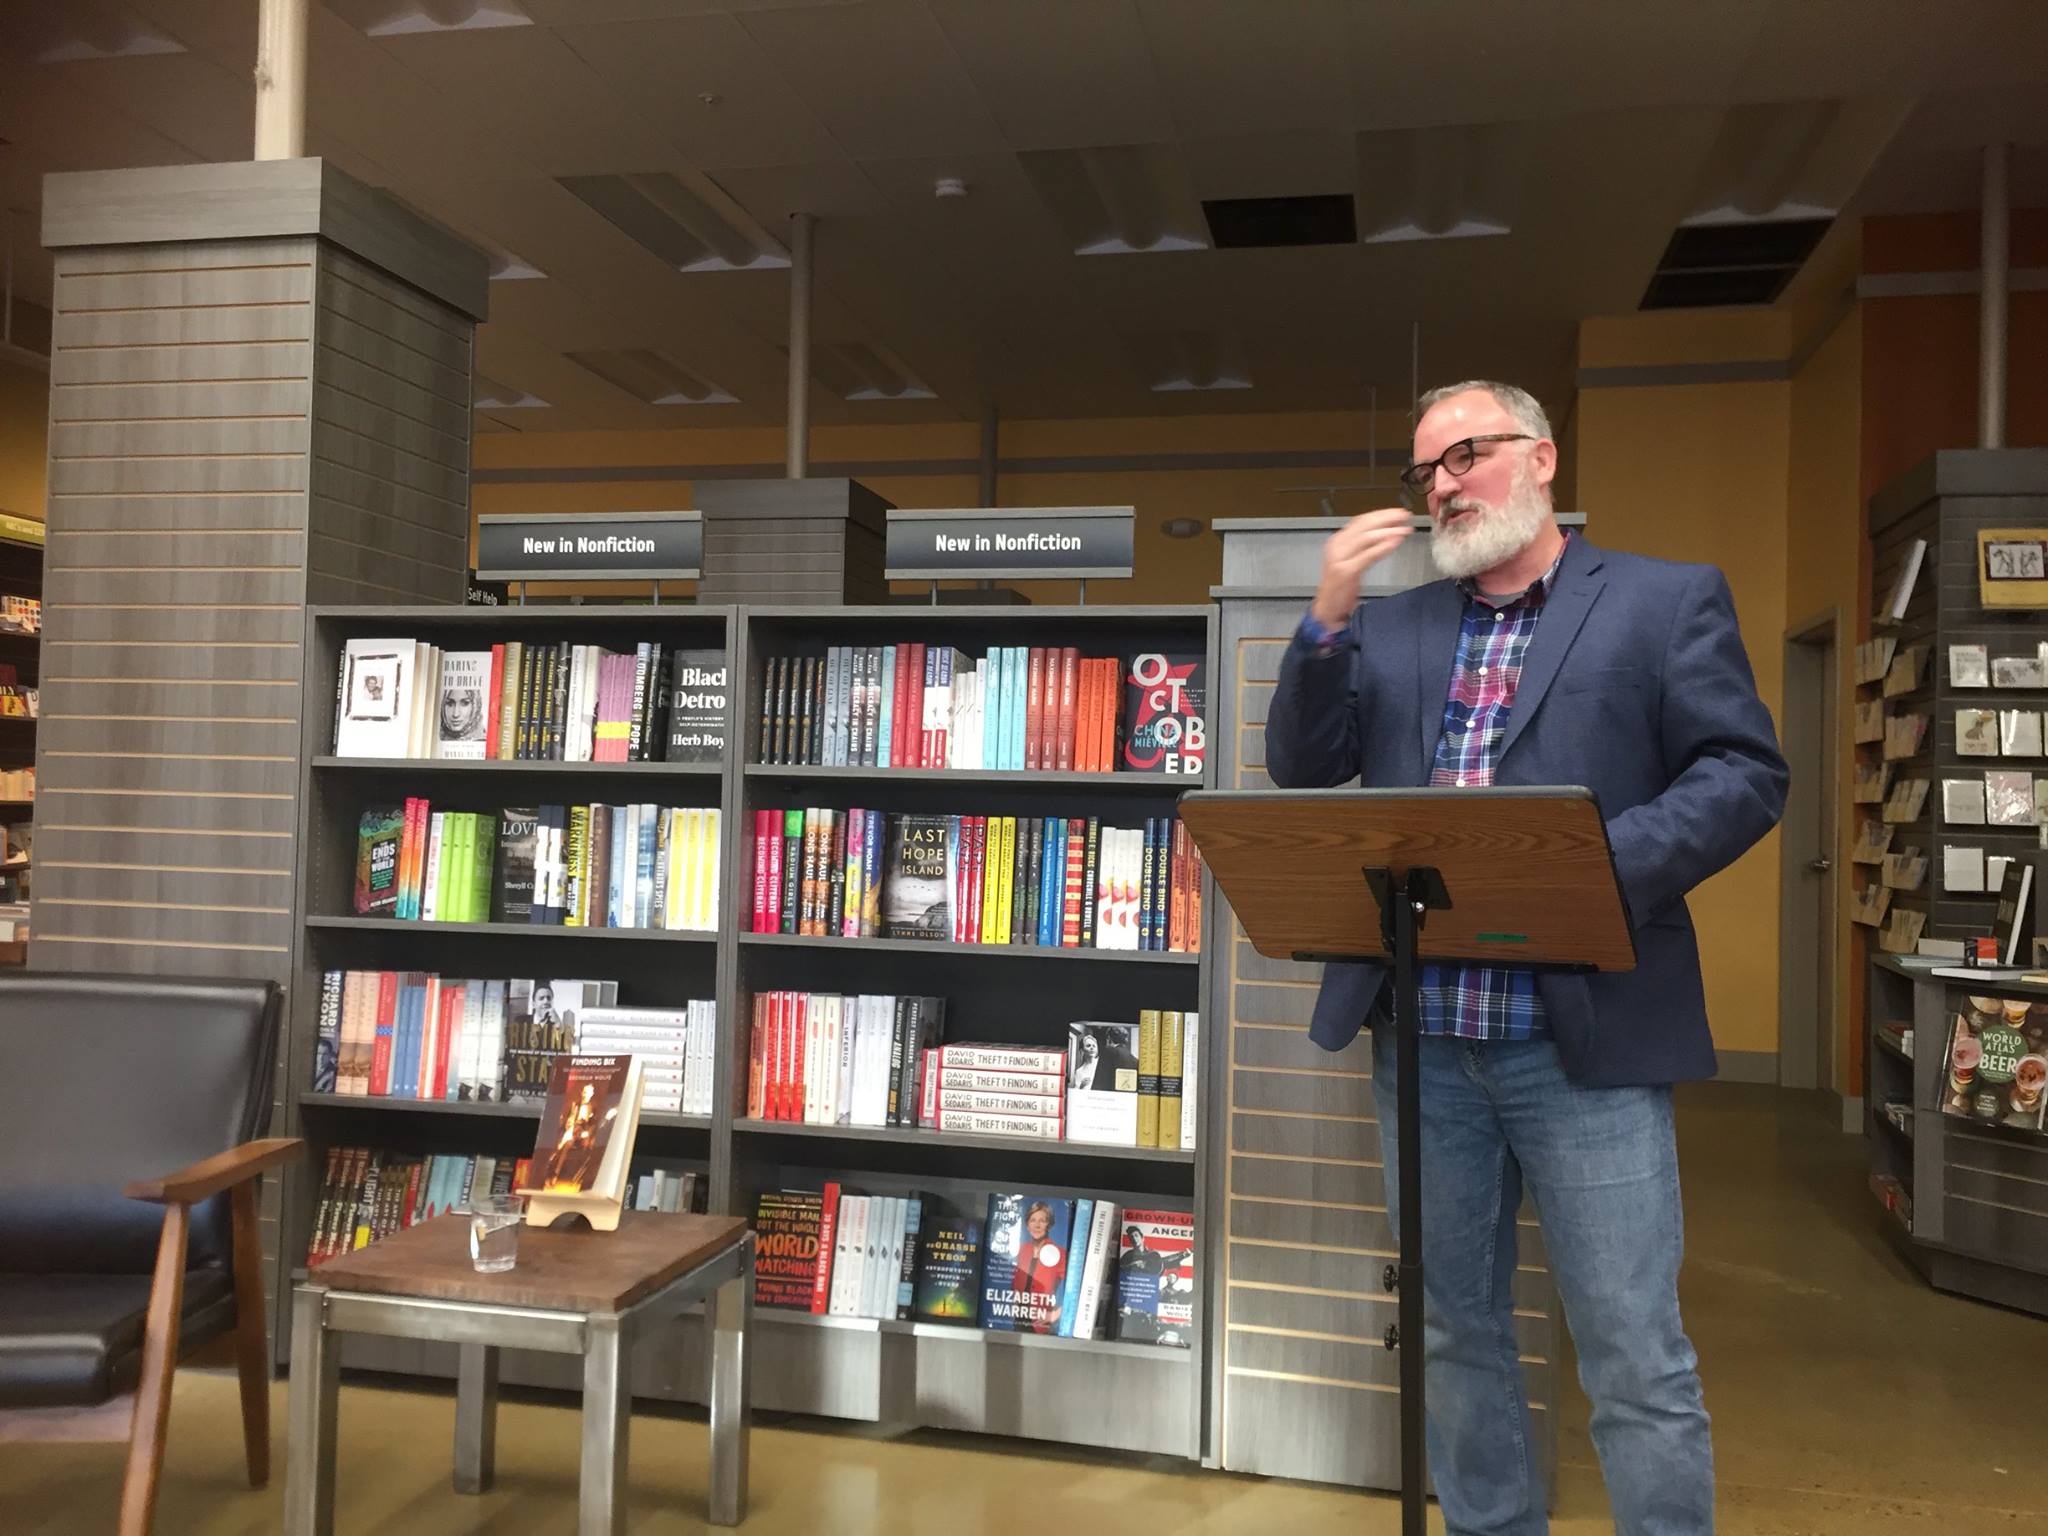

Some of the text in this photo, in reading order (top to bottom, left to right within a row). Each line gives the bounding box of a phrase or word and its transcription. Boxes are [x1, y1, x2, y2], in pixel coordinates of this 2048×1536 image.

[524, 536, 655, 554] New in Nonfiction
[936, 533, 1081, 551] New in Nonfiction
[468, 588, 498, 606] Self Help
[630, 652, 646, 750] BLOOMBERG POPE
[850, 677, 861, 752] DEMOCRACY IN CHAINS
[864, 677, 875, 752] DEMOCRACY IN CHAINS
[672, 734, 700, 746] Herb
[904, 829, 945, 842] LAST
[1089, 820, 1097, 842] THOMAS
[568, 810, 584, 874] WARNINGS
[960, 824, 971, 872] PAPI
[973, 824, 984, 872] PAPI
[372, 843, 395, 860] ENDS
[757, 836, 765, 874] BECOMING
[770, 836, 779, 874] BECOMING
[903, 848, 944, 861] HOPE
[1087, 851, 1095, 868] RICKS
[372, 859, 394, 872] WORLD
[806, 856, 815, 880] HAUL
[818, 856, 827, 880] HAUL
[902, 864, 944, 876] ISLAND
[1144, 848, 1153, 885] DOUBLE
[1158, 848, 1167, 885] DOUBLE
[1086, 870, 1094, 900] CHURCHILL
[320, 974, 331, 1026] NIXON
[328, 974, 341, 1027] RICHARD
[509, 1024, 574, 1049] RISING
[1983, 1032, 2021, 1046] WORLD
[892, 1041, 902, 1068] ANALOG
[1985, 1042, 2015, 1054] ATLAS
[947, 1057, 974, 1066] SEDARIS
[978, 1055, 1039, 1067] THEFT FINDING
[1979, 1054, 2016, 1073] BEER
[946, 1071, 973, 1079] DAVID
[976, 1076, 1038, 1089] THEFT FINDING
[946, 1080, 973, 1088] SEDARIS
[945, 1101, 972, 1109] SEDARIS
[975, 1098, 1037, 1111] THEFT FINDING
[945, 1114, 972, 1122] DAVID
[945, 1122, 972, 1130] SEDARIS
[975, 1119, 1037, 1132] THEFT FINDING
[998, 1201, 1018, 1211] THIS
[758, 1210, 796, 1220] INVISIBLE
[775, 1221, 789, 1232] THE
[792, 1224, 819, 1234] WHOLE
[822, 1224, 830, 1240] DAYS
[939, 1231, 965, 1240] NEIL
[754, 1234, 819, 1259] WORLD
[818, 1251, 827, 1273] BLACK
[933, 1252, 966, 1262] TYSON
[756, 1258, 817, 1276] WATCHING
[986, 1288, 1056, 1307] ELIZABETH
[992, 1303, 1046, 1320] WARREN
